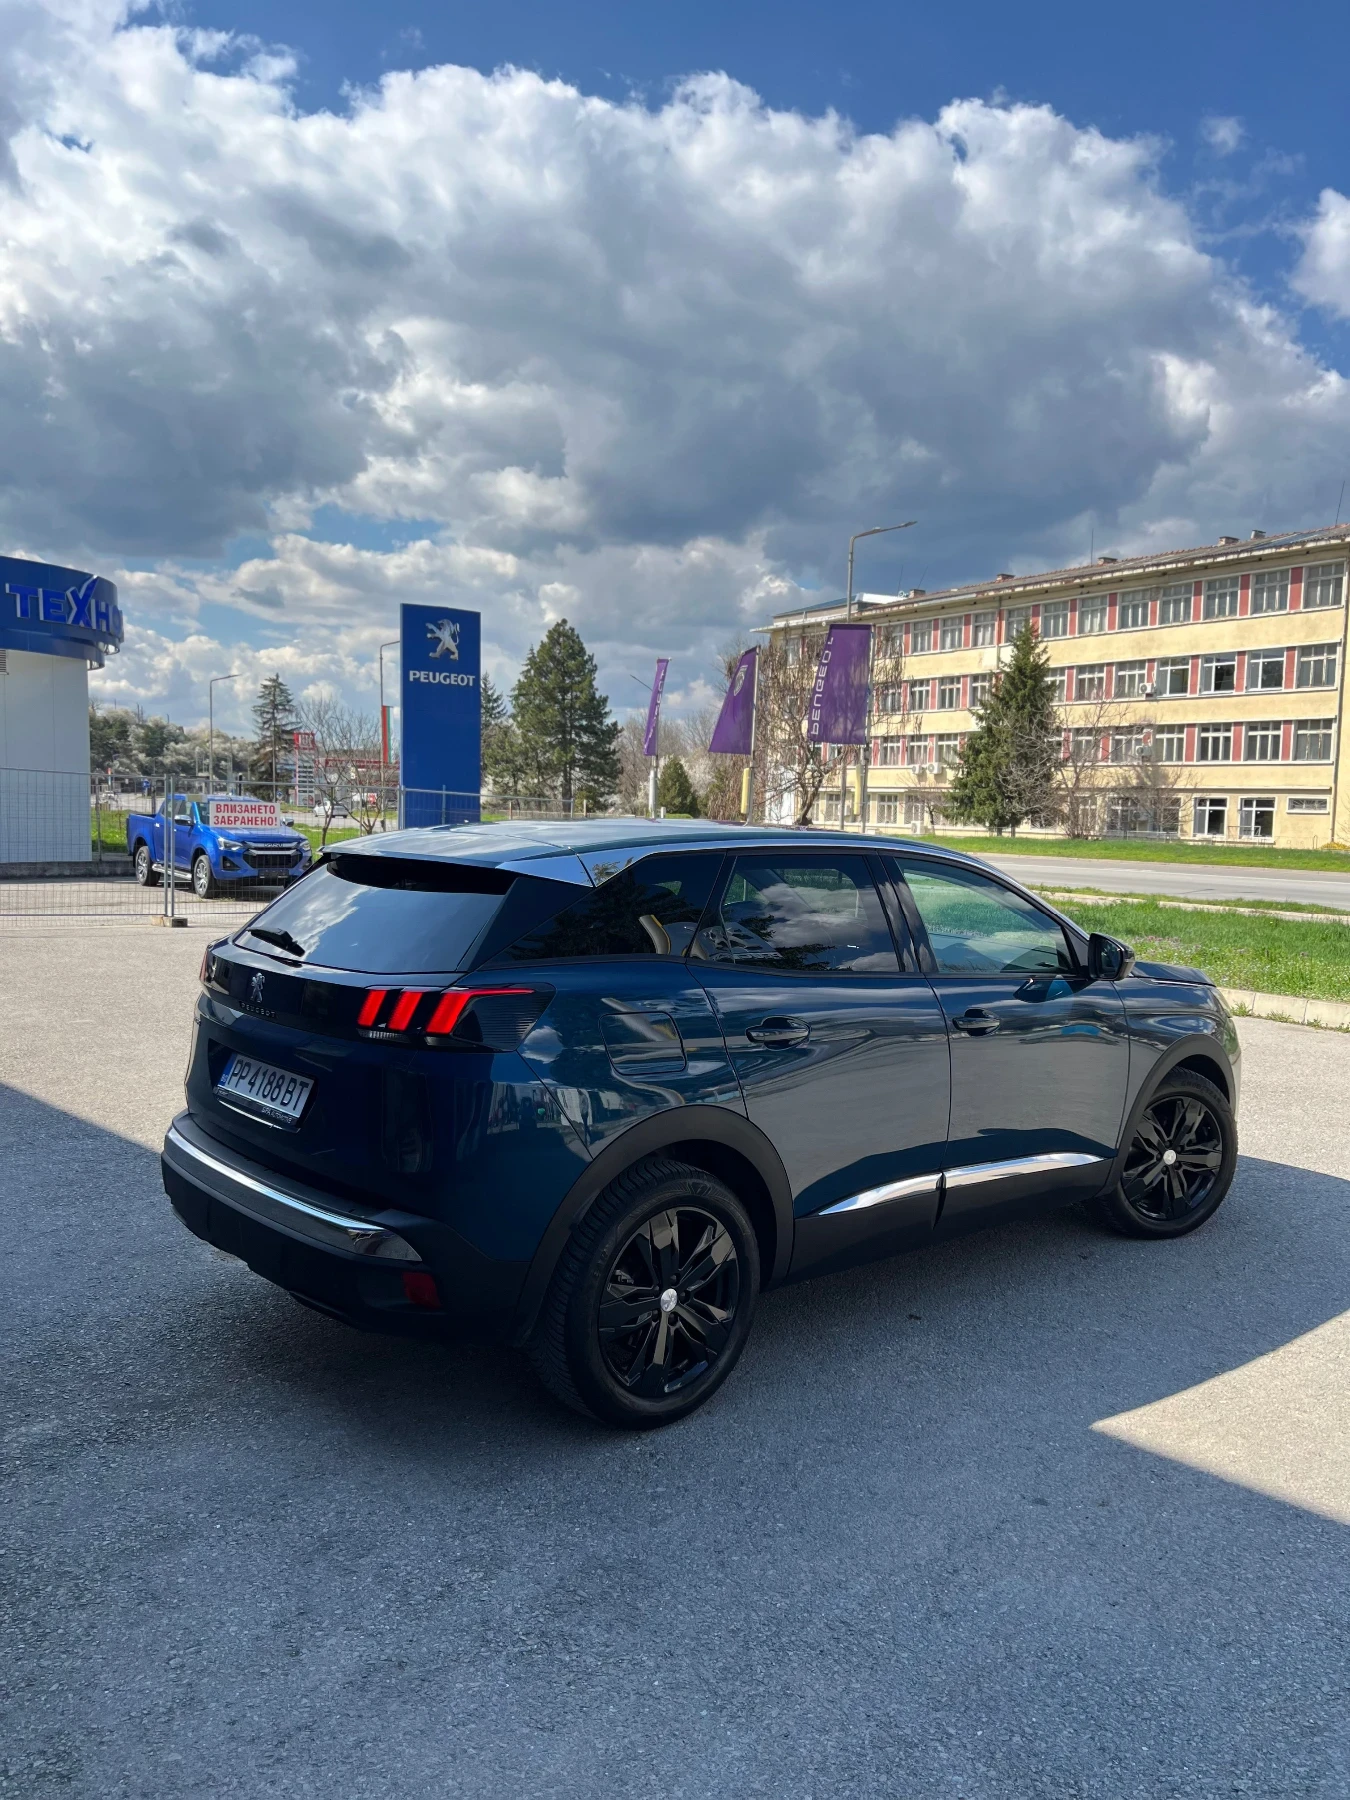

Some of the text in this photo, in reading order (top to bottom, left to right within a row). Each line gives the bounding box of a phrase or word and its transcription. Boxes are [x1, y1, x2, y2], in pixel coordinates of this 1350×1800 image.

[409, 670, 475, 686] PEUGEOT
[215, 803, 276, 815] ВЛИЗАНЕТО
[213, 815, 278, 827] ЗАБРАНЕНО!
